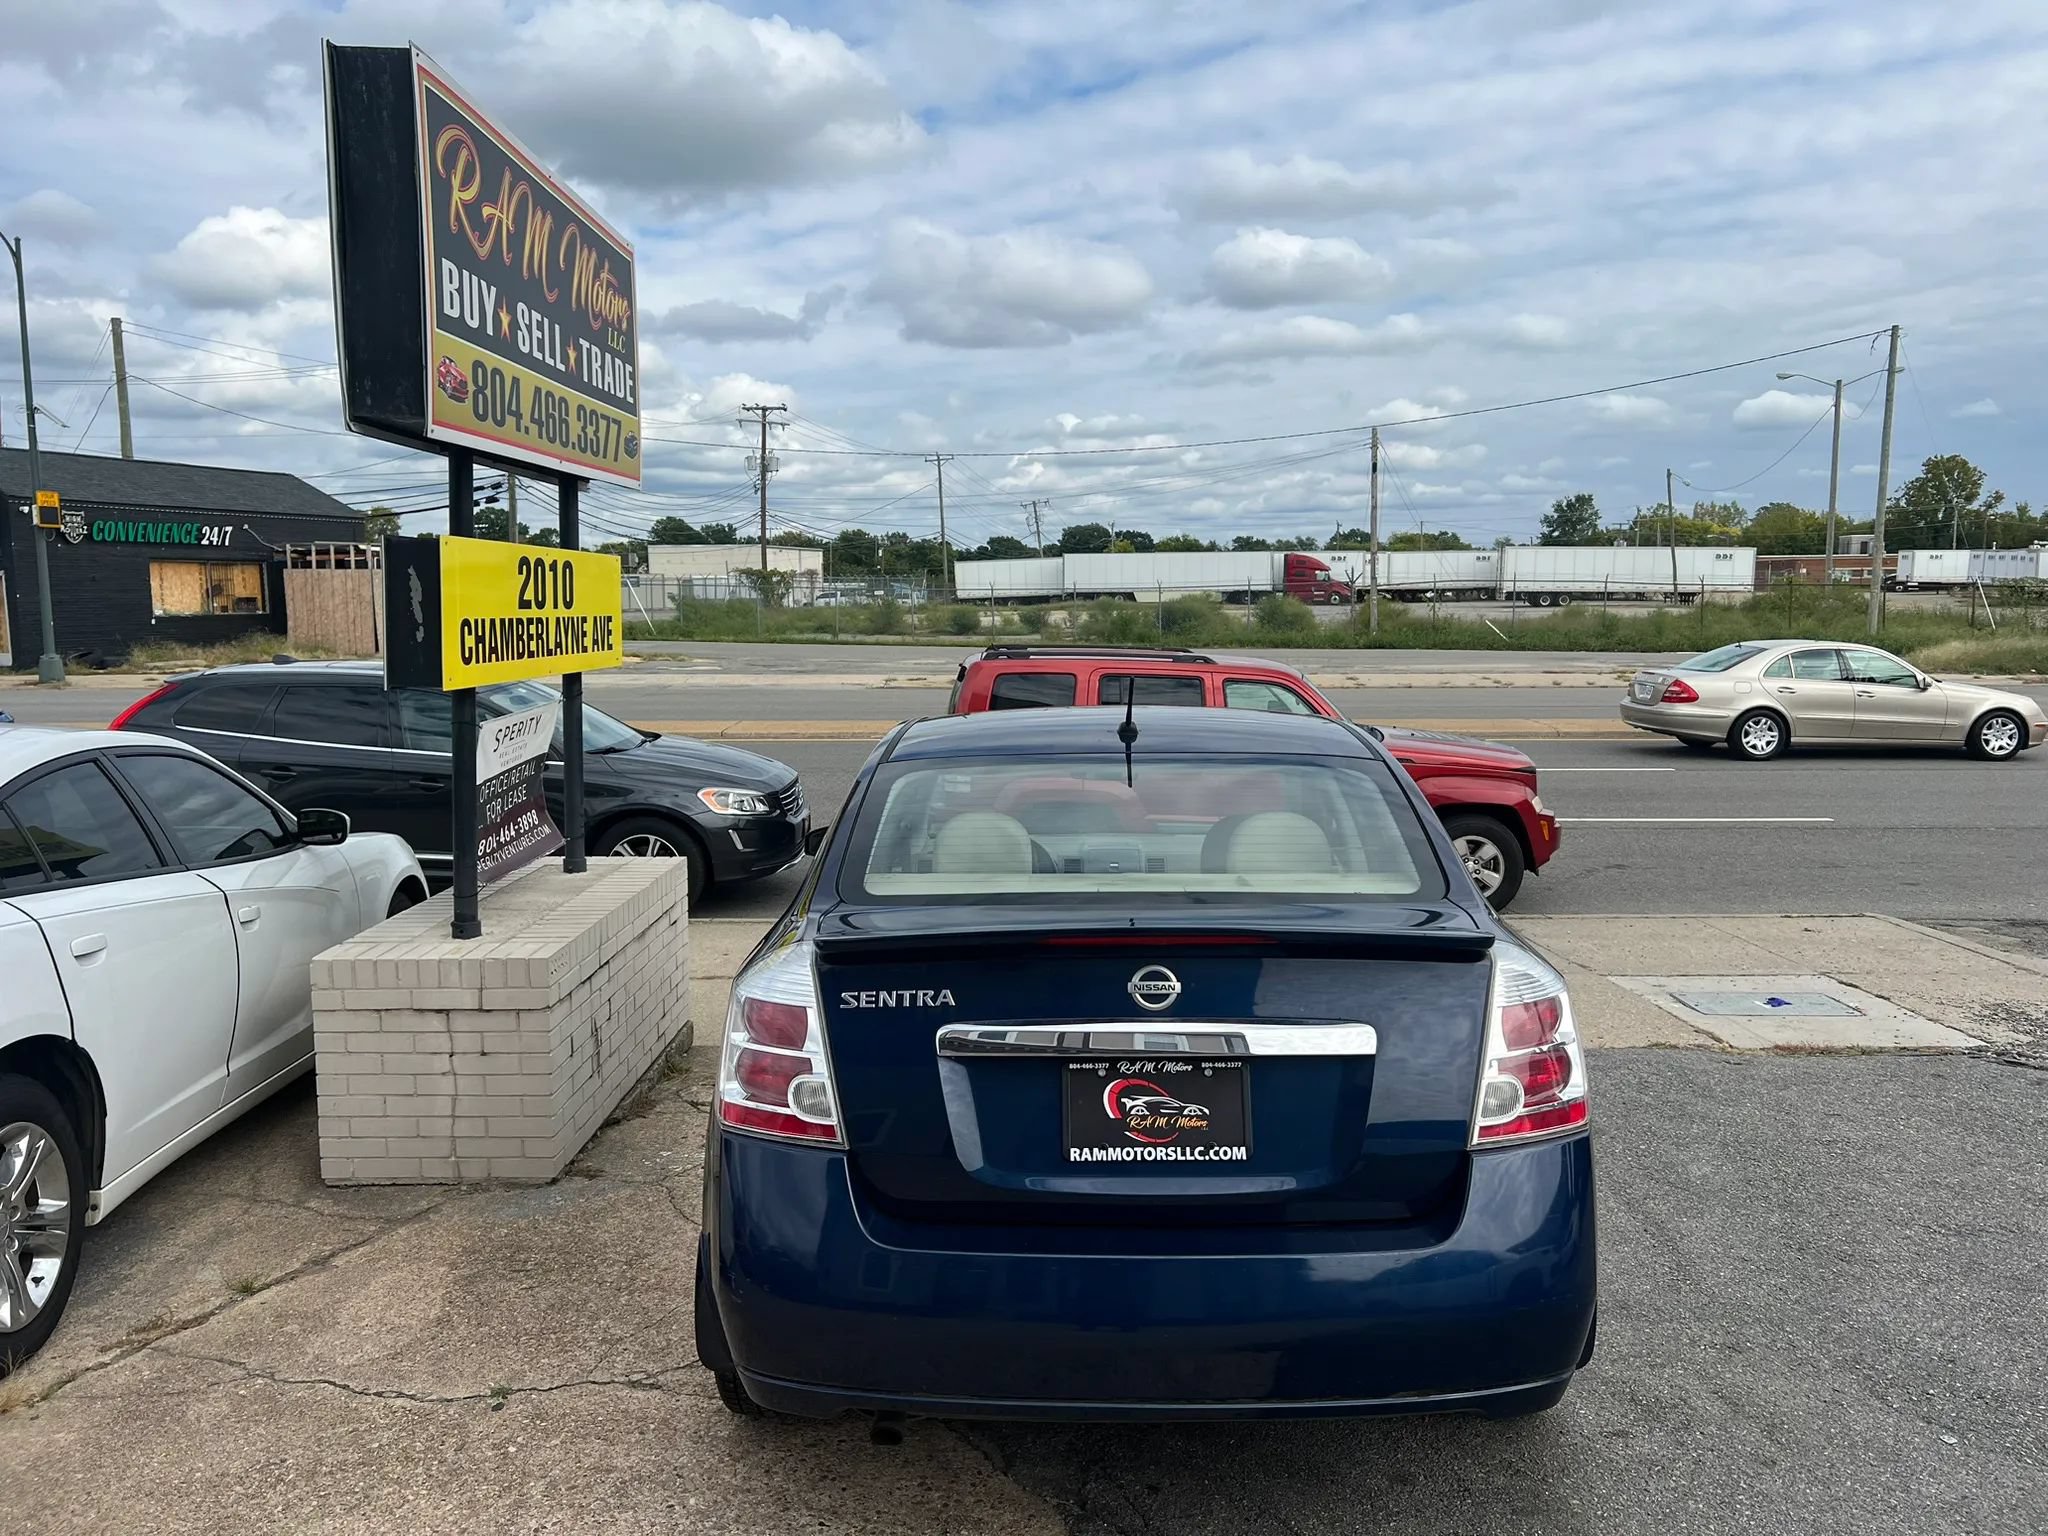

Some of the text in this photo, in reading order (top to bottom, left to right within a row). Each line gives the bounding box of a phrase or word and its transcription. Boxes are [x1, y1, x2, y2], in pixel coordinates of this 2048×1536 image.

[436, 124, 631, 331] RAM Motors
[441, 257, 635, 404] BUY SELL TRADE
[608, 327, 626, 353] LLC
[471, 359, 622, 463] 804.466.3377
[92, 520, 234, 547] CONVENIENCE 24/7
[517, 556, 575, 610] 2010
[460, 615, 613, 666] CHAMBERLAYNE AVE
[493, 713, 543, 753] SPERITY
[479, 760, 536, 804] OFFICE/RETAIL
[486, 783, 528, 821] FOR LEASE
[839, 988, 956, 1009] SENTRA
[1132, 982, 1177, 993] NISSAN
[1117, 1060, 1157, 1074] RAM
[1158, 1060, 1193, 1074] Motors
[1127, 1115, 1209, 1130] RAM Motors
[1069, 1145, 1248, 1162] RAMMOTORSLLC.COM
